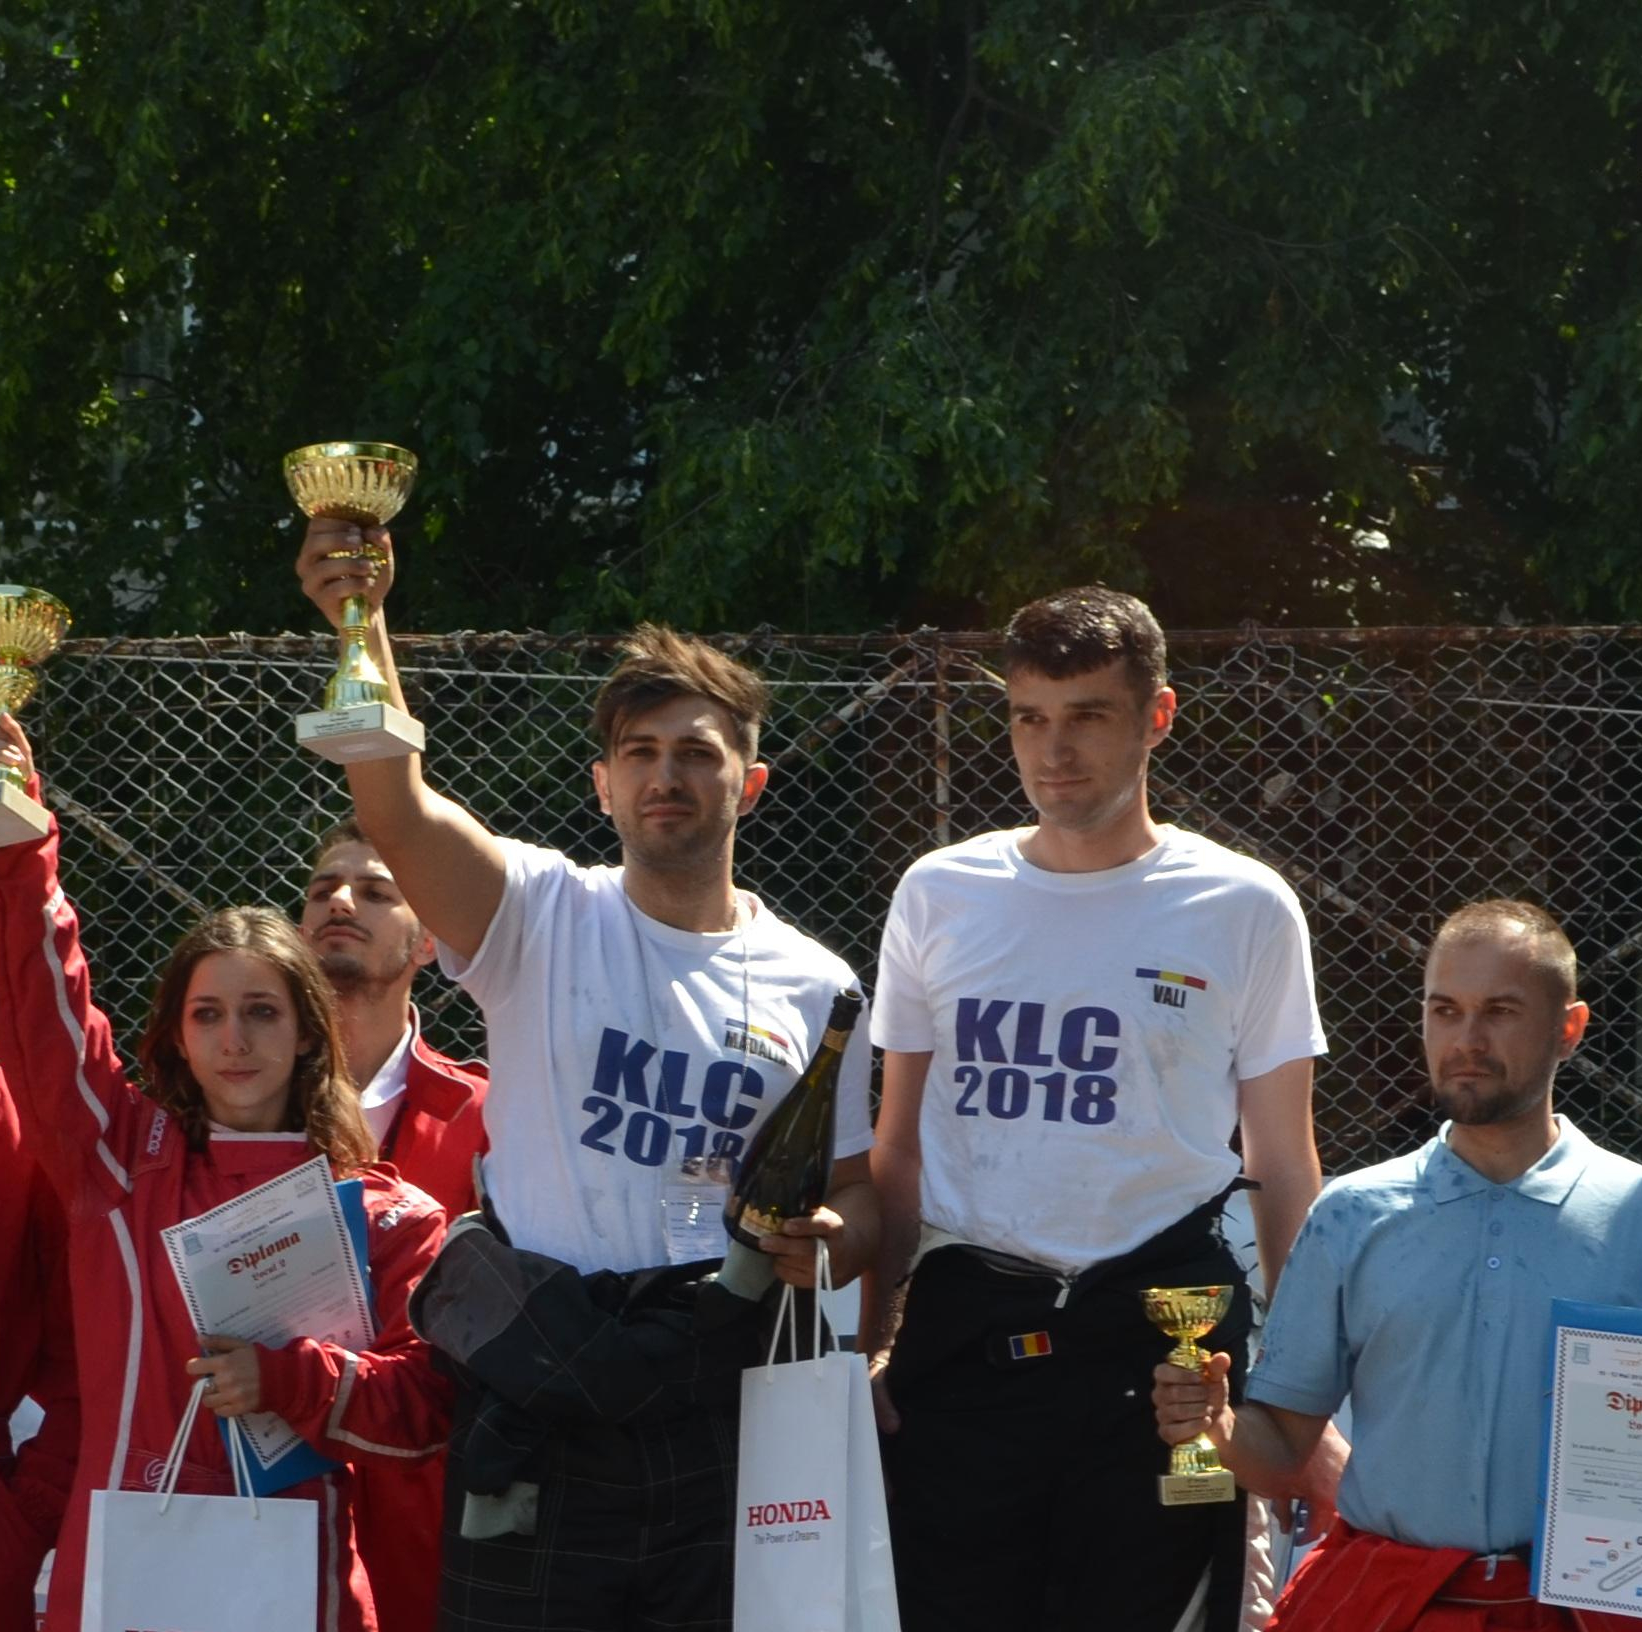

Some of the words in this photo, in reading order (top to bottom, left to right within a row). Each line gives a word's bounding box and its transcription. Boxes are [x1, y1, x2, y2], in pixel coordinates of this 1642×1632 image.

[1153, 984, 1186, 1009] VALI
[956, 998, 1120, 1072] KLC
[592, 1027, 765, 1130] KLC
[954, 1065, 1118, 1126] 2018
[580, 1096, 746, 1187] 2018
[227, 1231, 301, 1275] Diploma
[746, 1499, 831, 1527] HONDA
